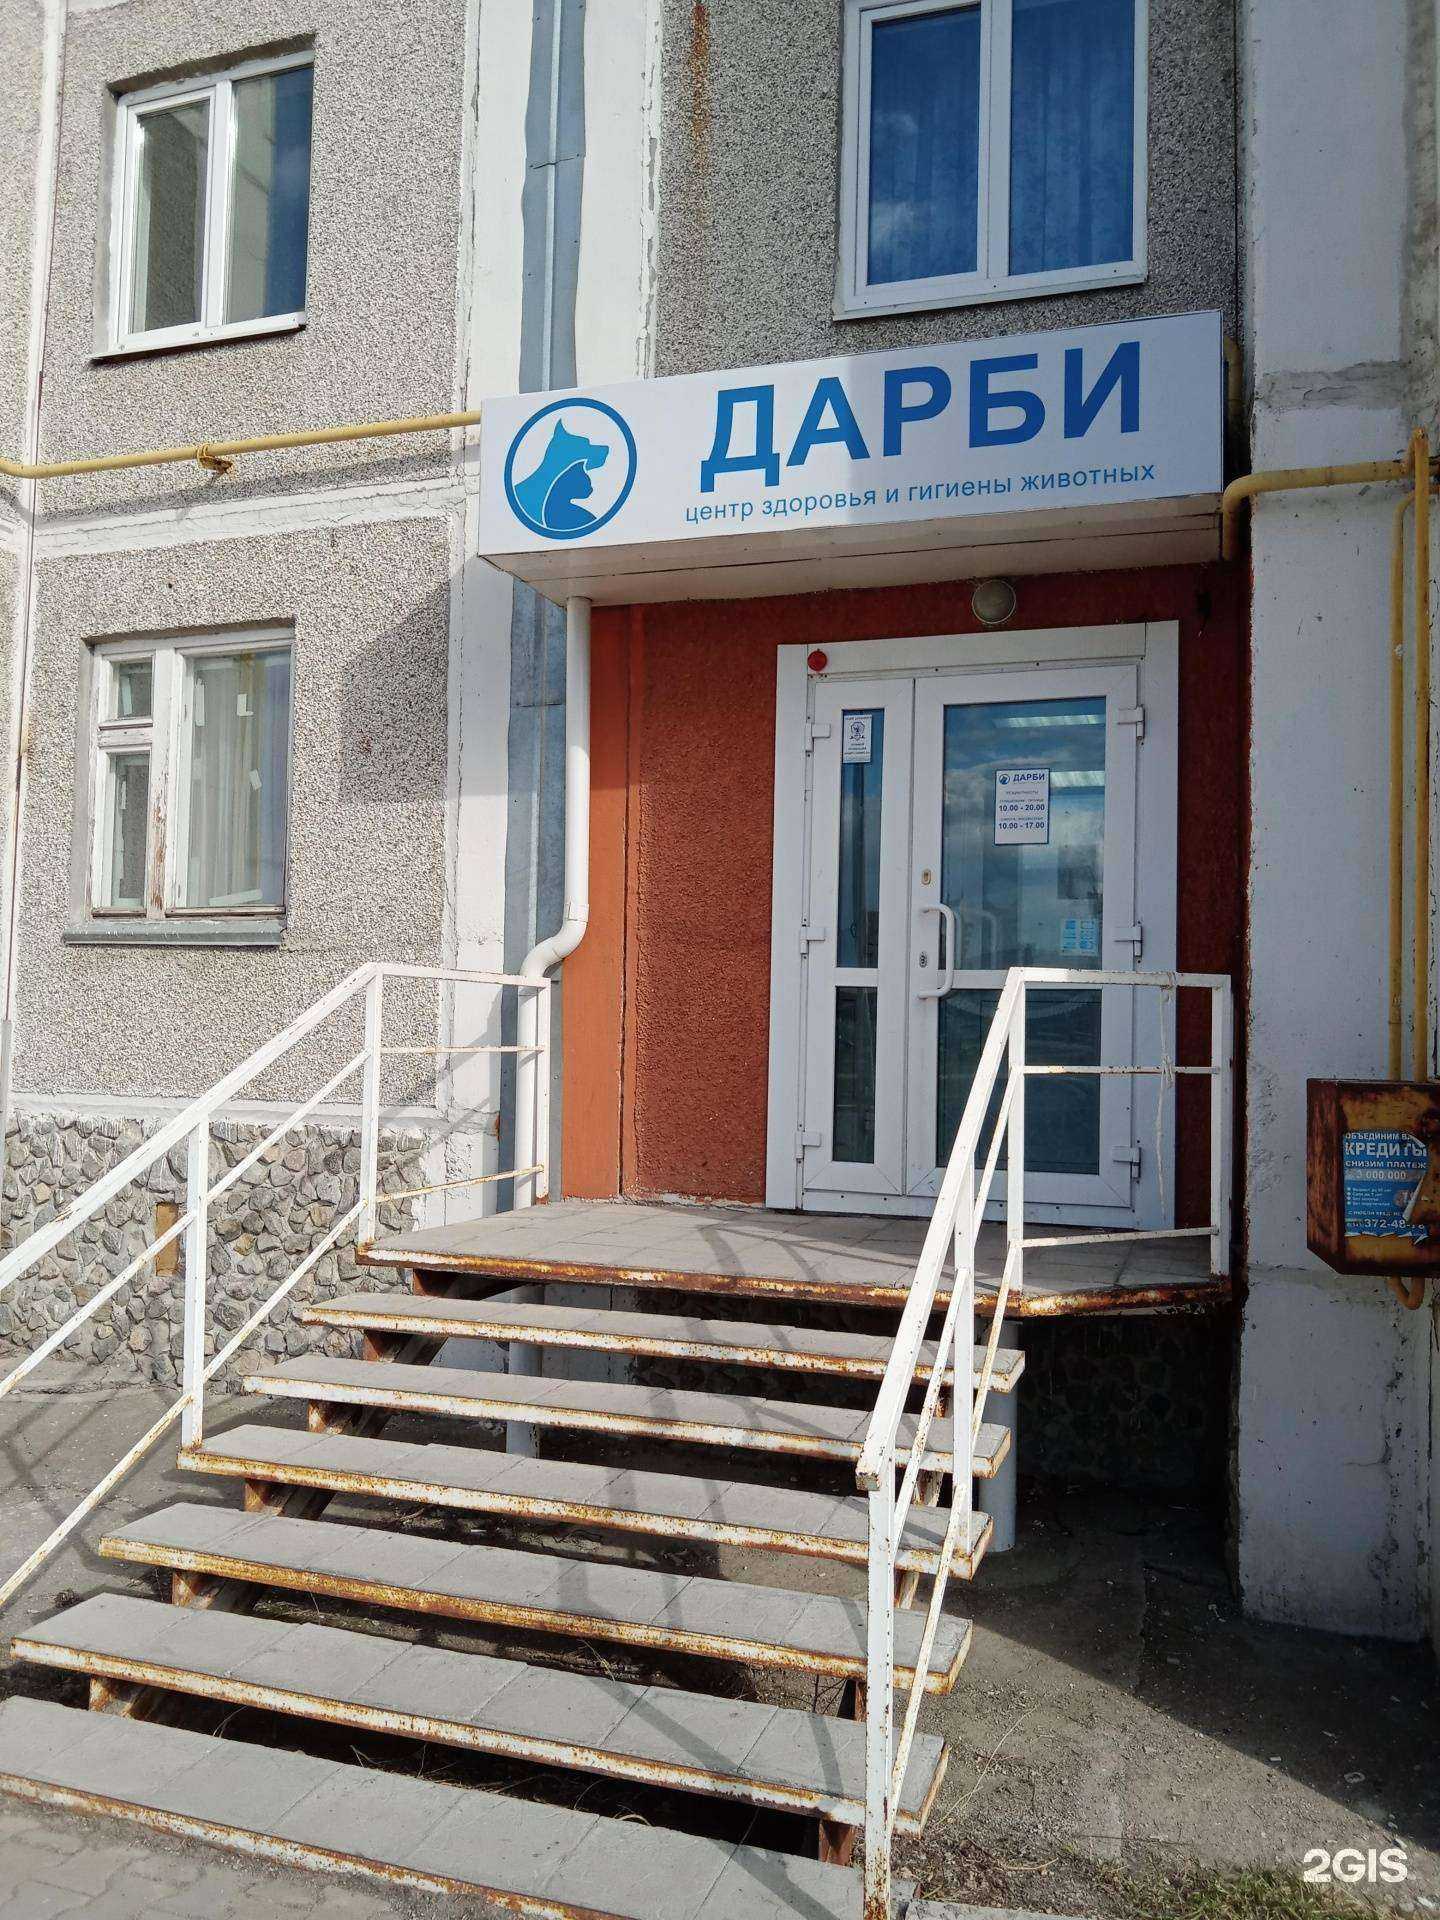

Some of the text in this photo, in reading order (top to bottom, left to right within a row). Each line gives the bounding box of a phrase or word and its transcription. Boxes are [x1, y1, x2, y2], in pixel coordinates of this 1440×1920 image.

[700, 340, 1141, 492] ДАРБИ
[685, 464, 1155, 525] центр здоровья и гигиены животных
[1013, 773, 1045, 782] ДАРБИ
[998, 804, 1018, 812] 10.00
[998, 822, 1018, 830] 10.00
[1345, 1132, 1400, 1141] ОБЪЕДИНИМ
[1345, 1142, 1427, 1159] КРЕДИТЫ
[1345, 1160, 1426, 1169] СНИЗИМ ПЛАТЕЖ
